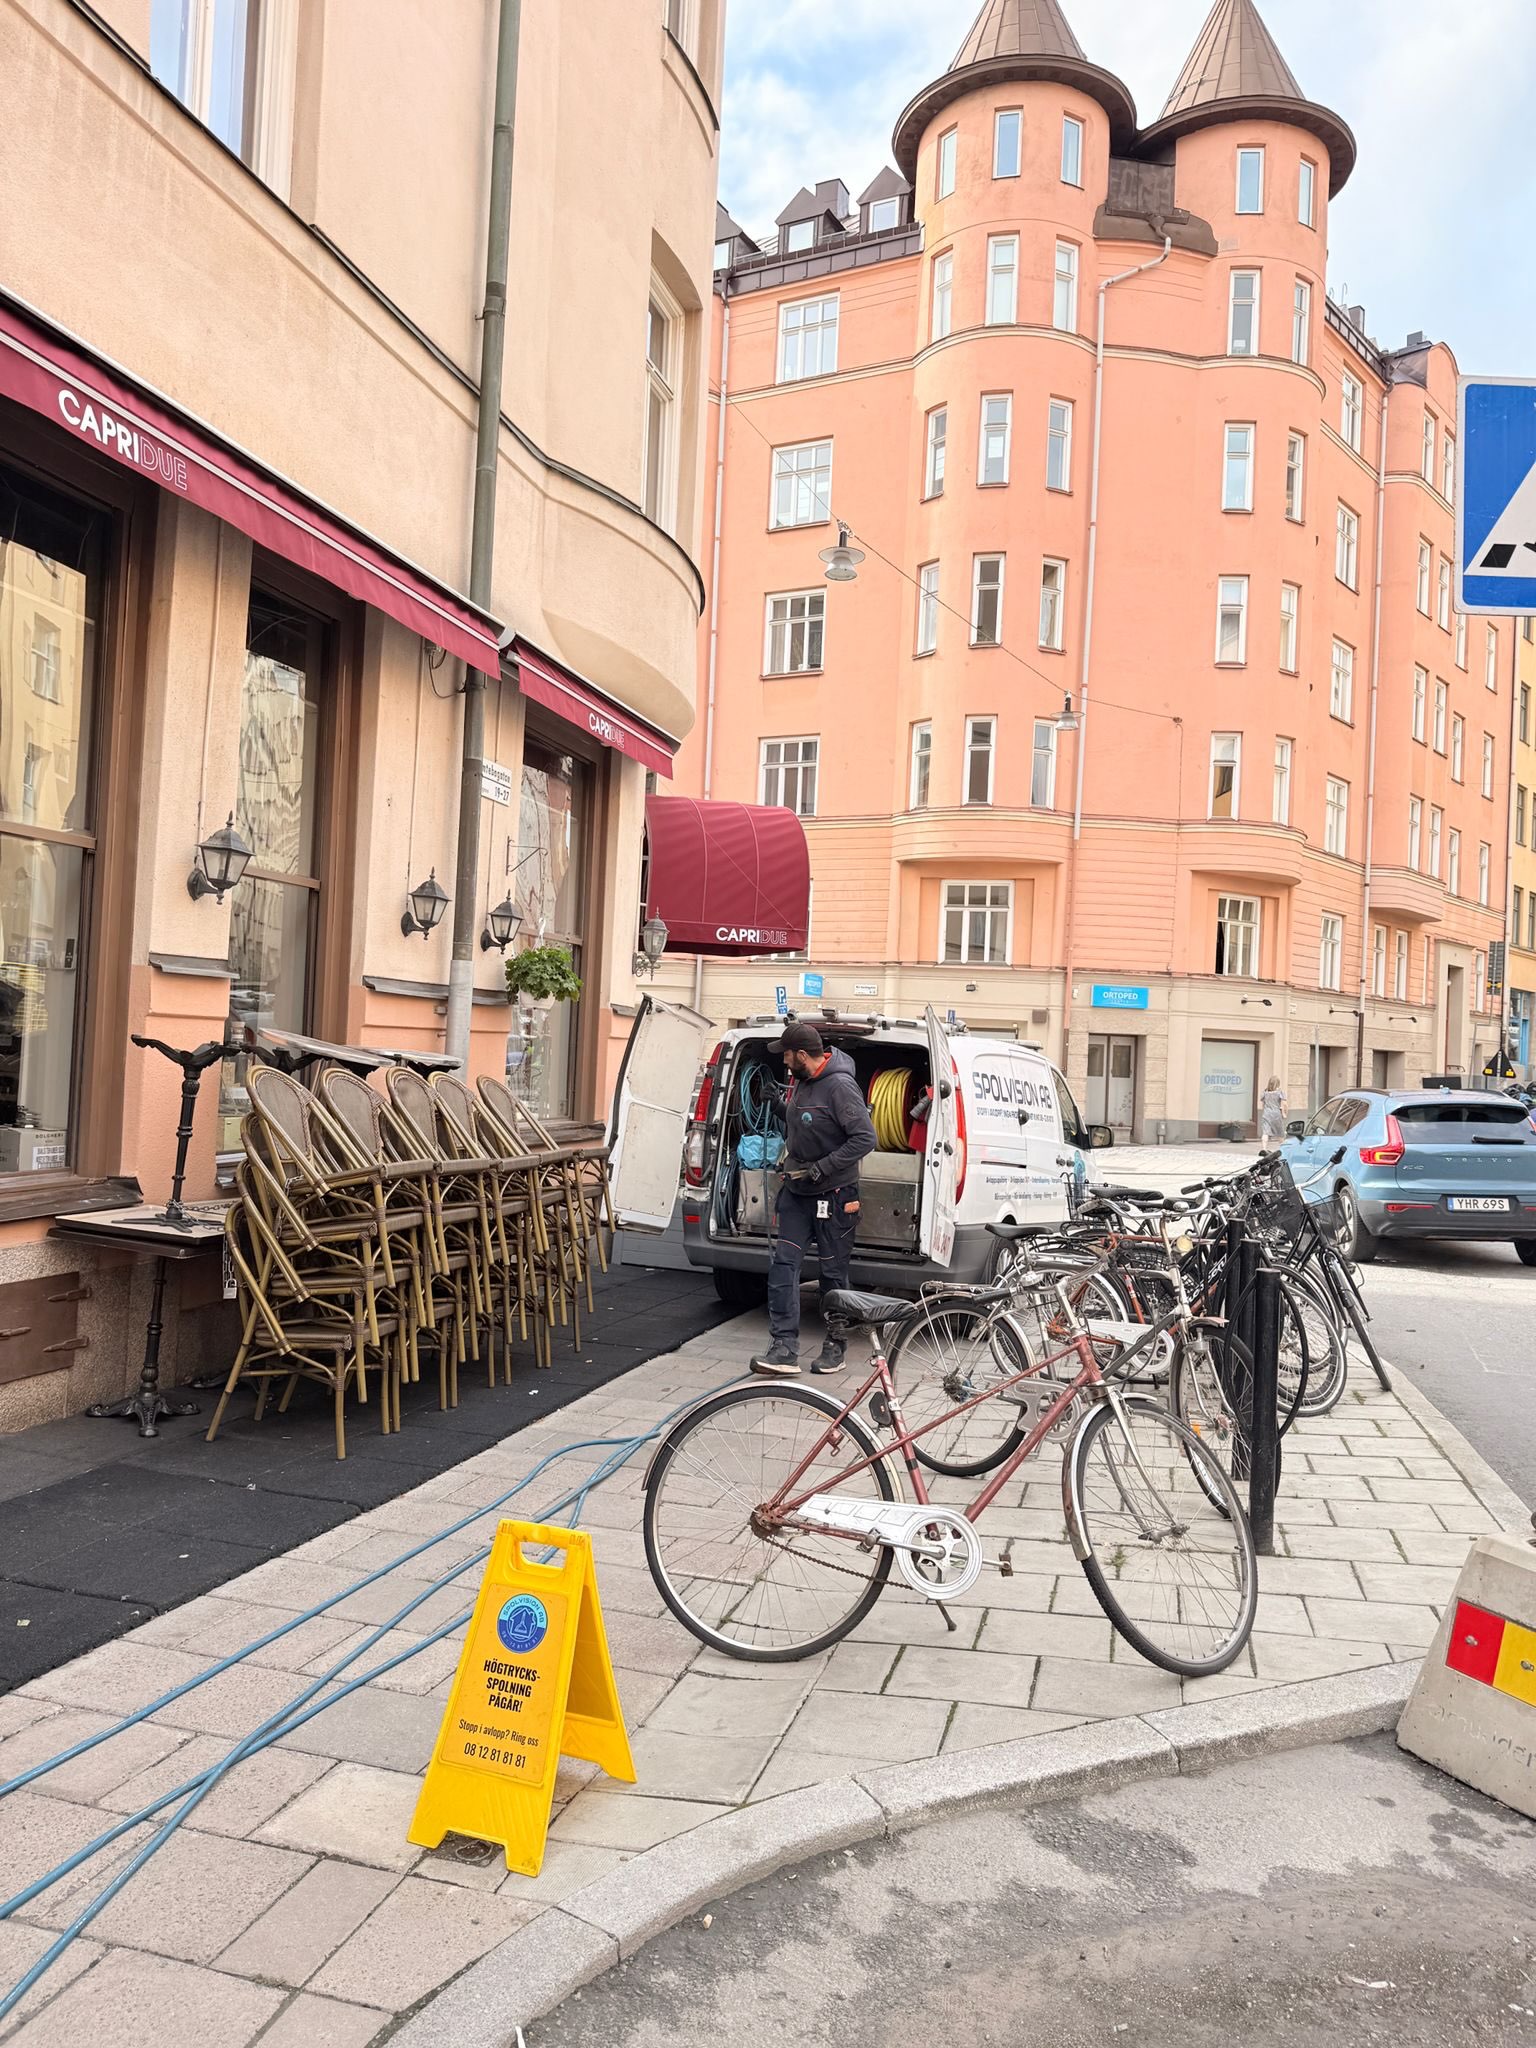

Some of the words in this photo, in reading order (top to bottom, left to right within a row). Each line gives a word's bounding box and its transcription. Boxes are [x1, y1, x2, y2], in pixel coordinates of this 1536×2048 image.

[1102, 991, 1139, 1000] ORTOPED
[972, 1071, 1040, 1106] SPOLVISION
[1039, 1084, 1053, 1109] AB
[1204, 1074, 1242, 1085] ORTOPED
[1457, 1198, 1479, 1210] YHR
[1482, 1198, 1505, 1210] 69S
[502, 1596, 541, 1616] SPOLVISION
[483, 1658, 541, 1682] HÖGTRYCKS-
[486, 1677, 532, 1698] SPOLNING
[488, 1692, 523, 1713] PÅGÅR!
[459, 1718, 478, 1734] Stopp
[483, 1726, 510, 1740] avlopp?
[511, 1729, 527, 1745] Ring
[527, 1736, 540, 1747] oss
[464, 1742, 477, 1756] 08
[479, 1745, 489, 1759] 12
[490, 1748, 501, 1763] 81
[502, 1751, 514, 1766] 81
[515, 1754, 526, 1769] 81
